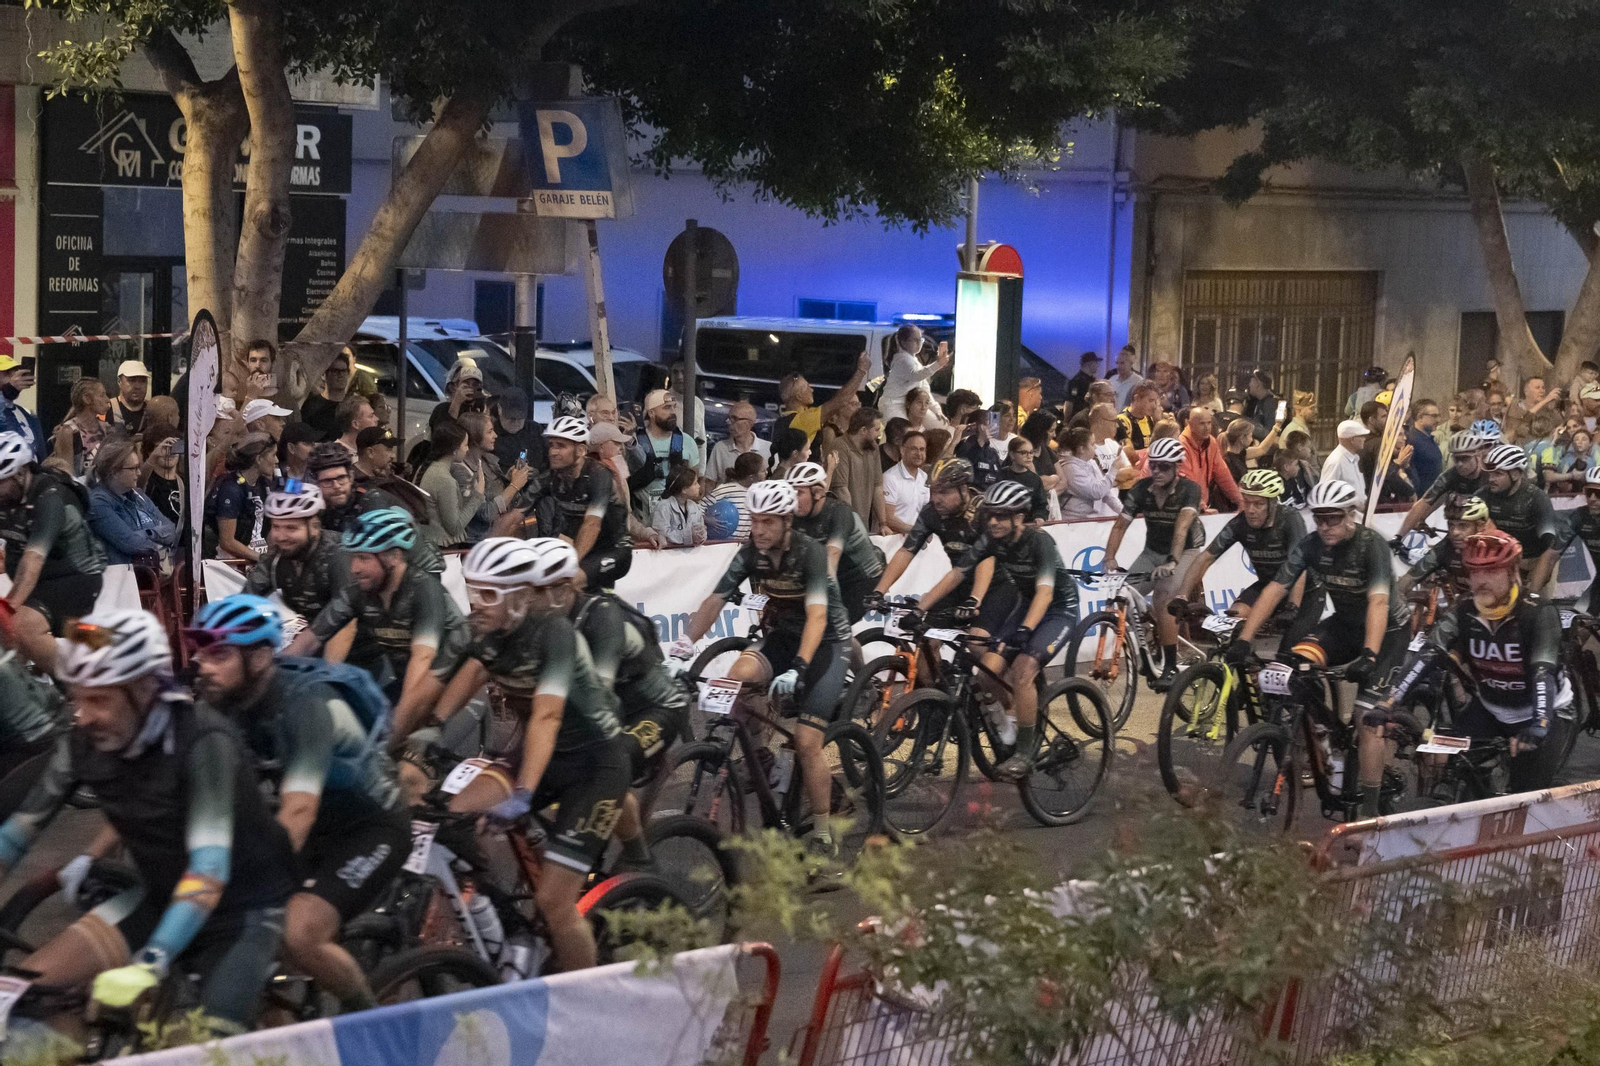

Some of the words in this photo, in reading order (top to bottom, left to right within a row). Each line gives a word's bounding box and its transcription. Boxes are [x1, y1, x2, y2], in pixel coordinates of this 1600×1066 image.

[536, 109, 588, 184] P
[539, 193, 575, 205] GARAJE
[580, 192, 610, 206] BELÉN
[55, 235, 93, 251] OFICINA
[286, 237, 304, 245] rmas
[304, 236, 337, 247] Integrales
[68, 256, 80, 272] DE
[48, 277, 99, 293] REFORMAS
[1469, 638, 1523, 663] UAE
